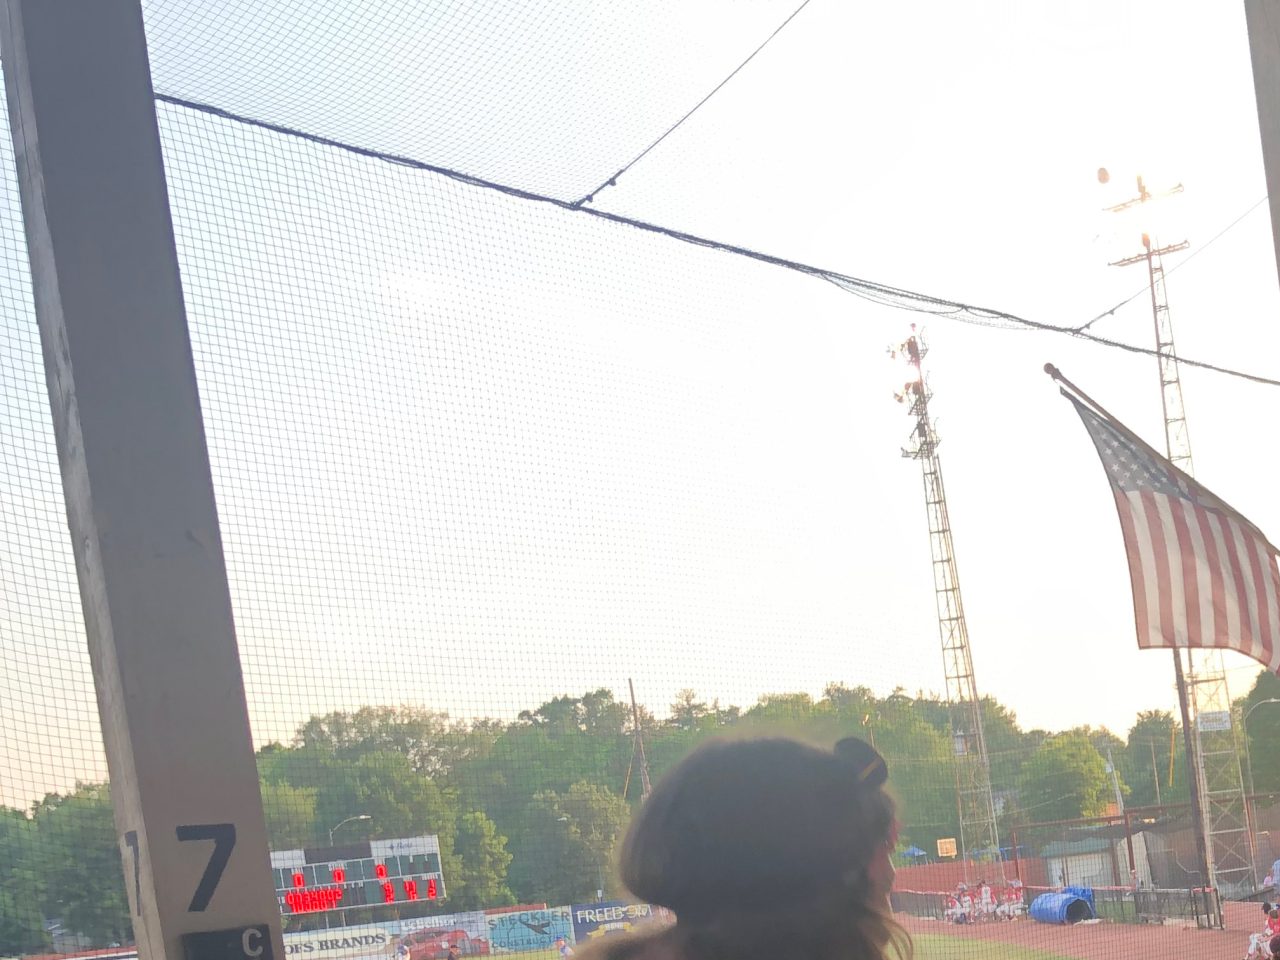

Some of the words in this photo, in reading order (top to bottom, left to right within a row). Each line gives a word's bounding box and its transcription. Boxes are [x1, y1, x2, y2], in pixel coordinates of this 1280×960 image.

[176, 823, 237, 912] 7
[333, 868, 345, 884] 0
[376, 864, 387, 879] 0
[488, 909, 570, 929] STECKLER
[319, 934, 387, 951] BRANDS
